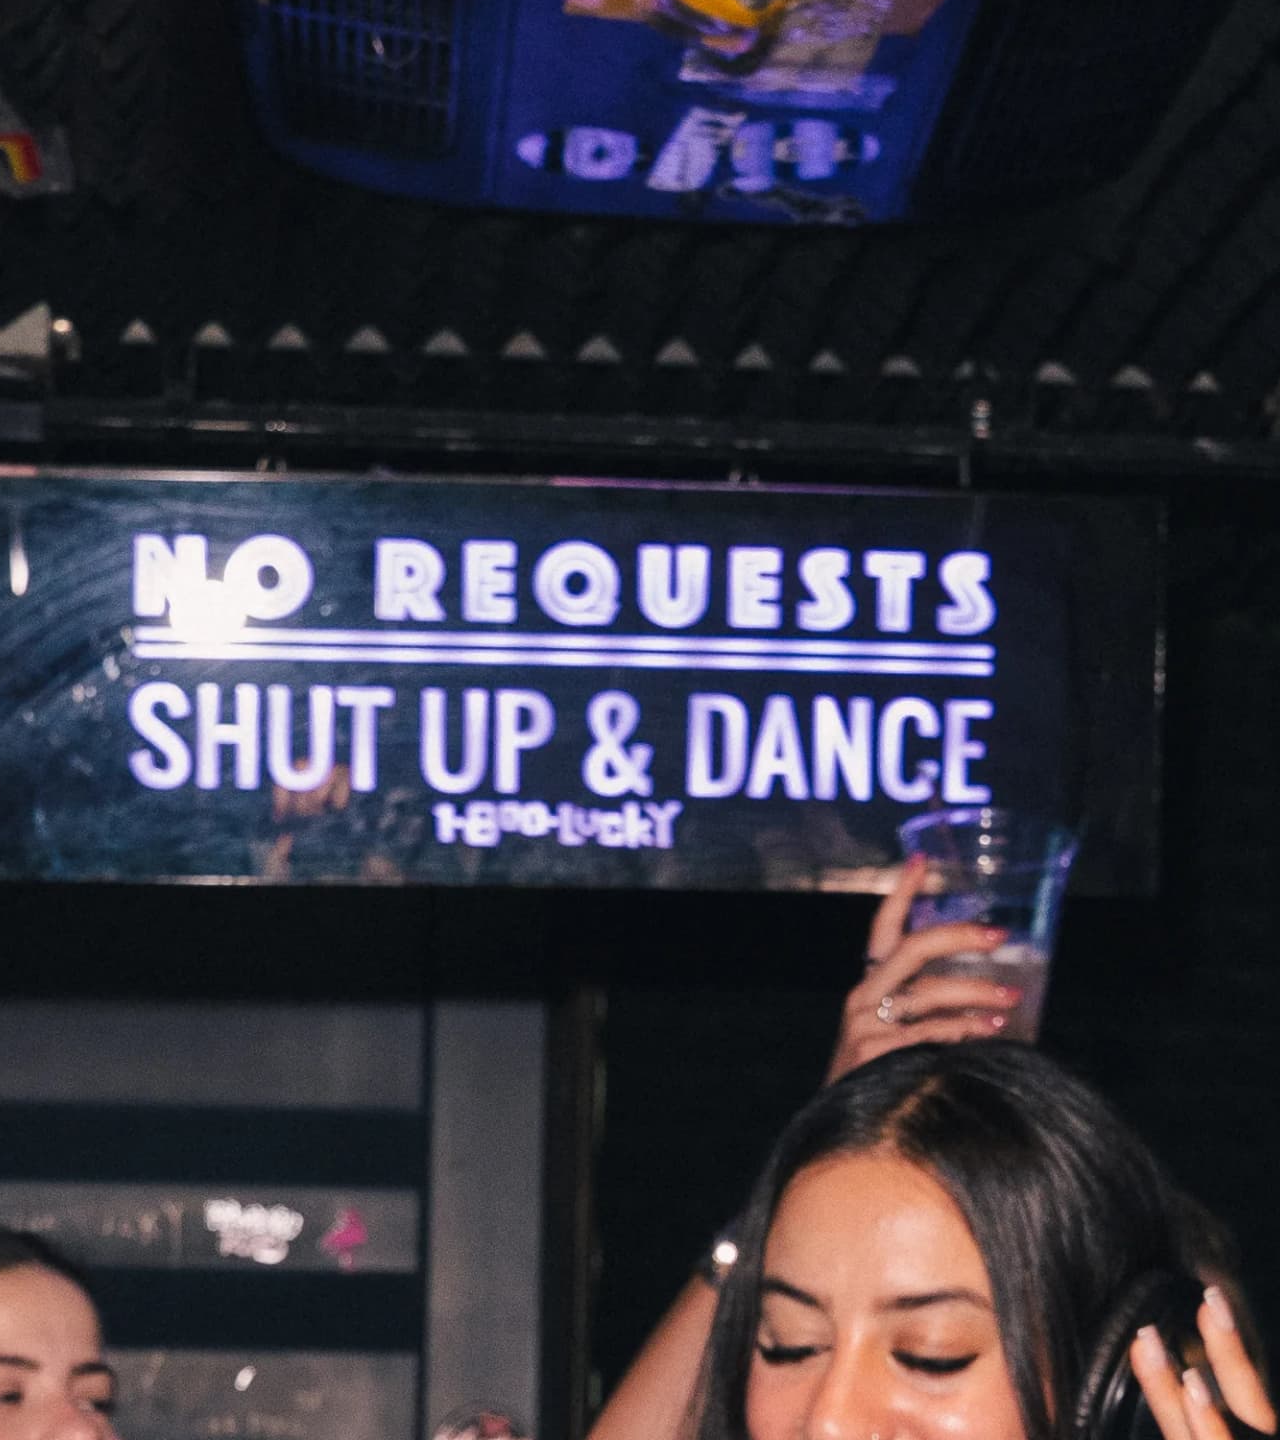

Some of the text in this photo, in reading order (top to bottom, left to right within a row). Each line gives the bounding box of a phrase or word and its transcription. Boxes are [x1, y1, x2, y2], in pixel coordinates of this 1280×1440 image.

[132, 533, 998, 636] NO REQUESTS
[127, 681, 996, 805] SHUT UP & DANCE
